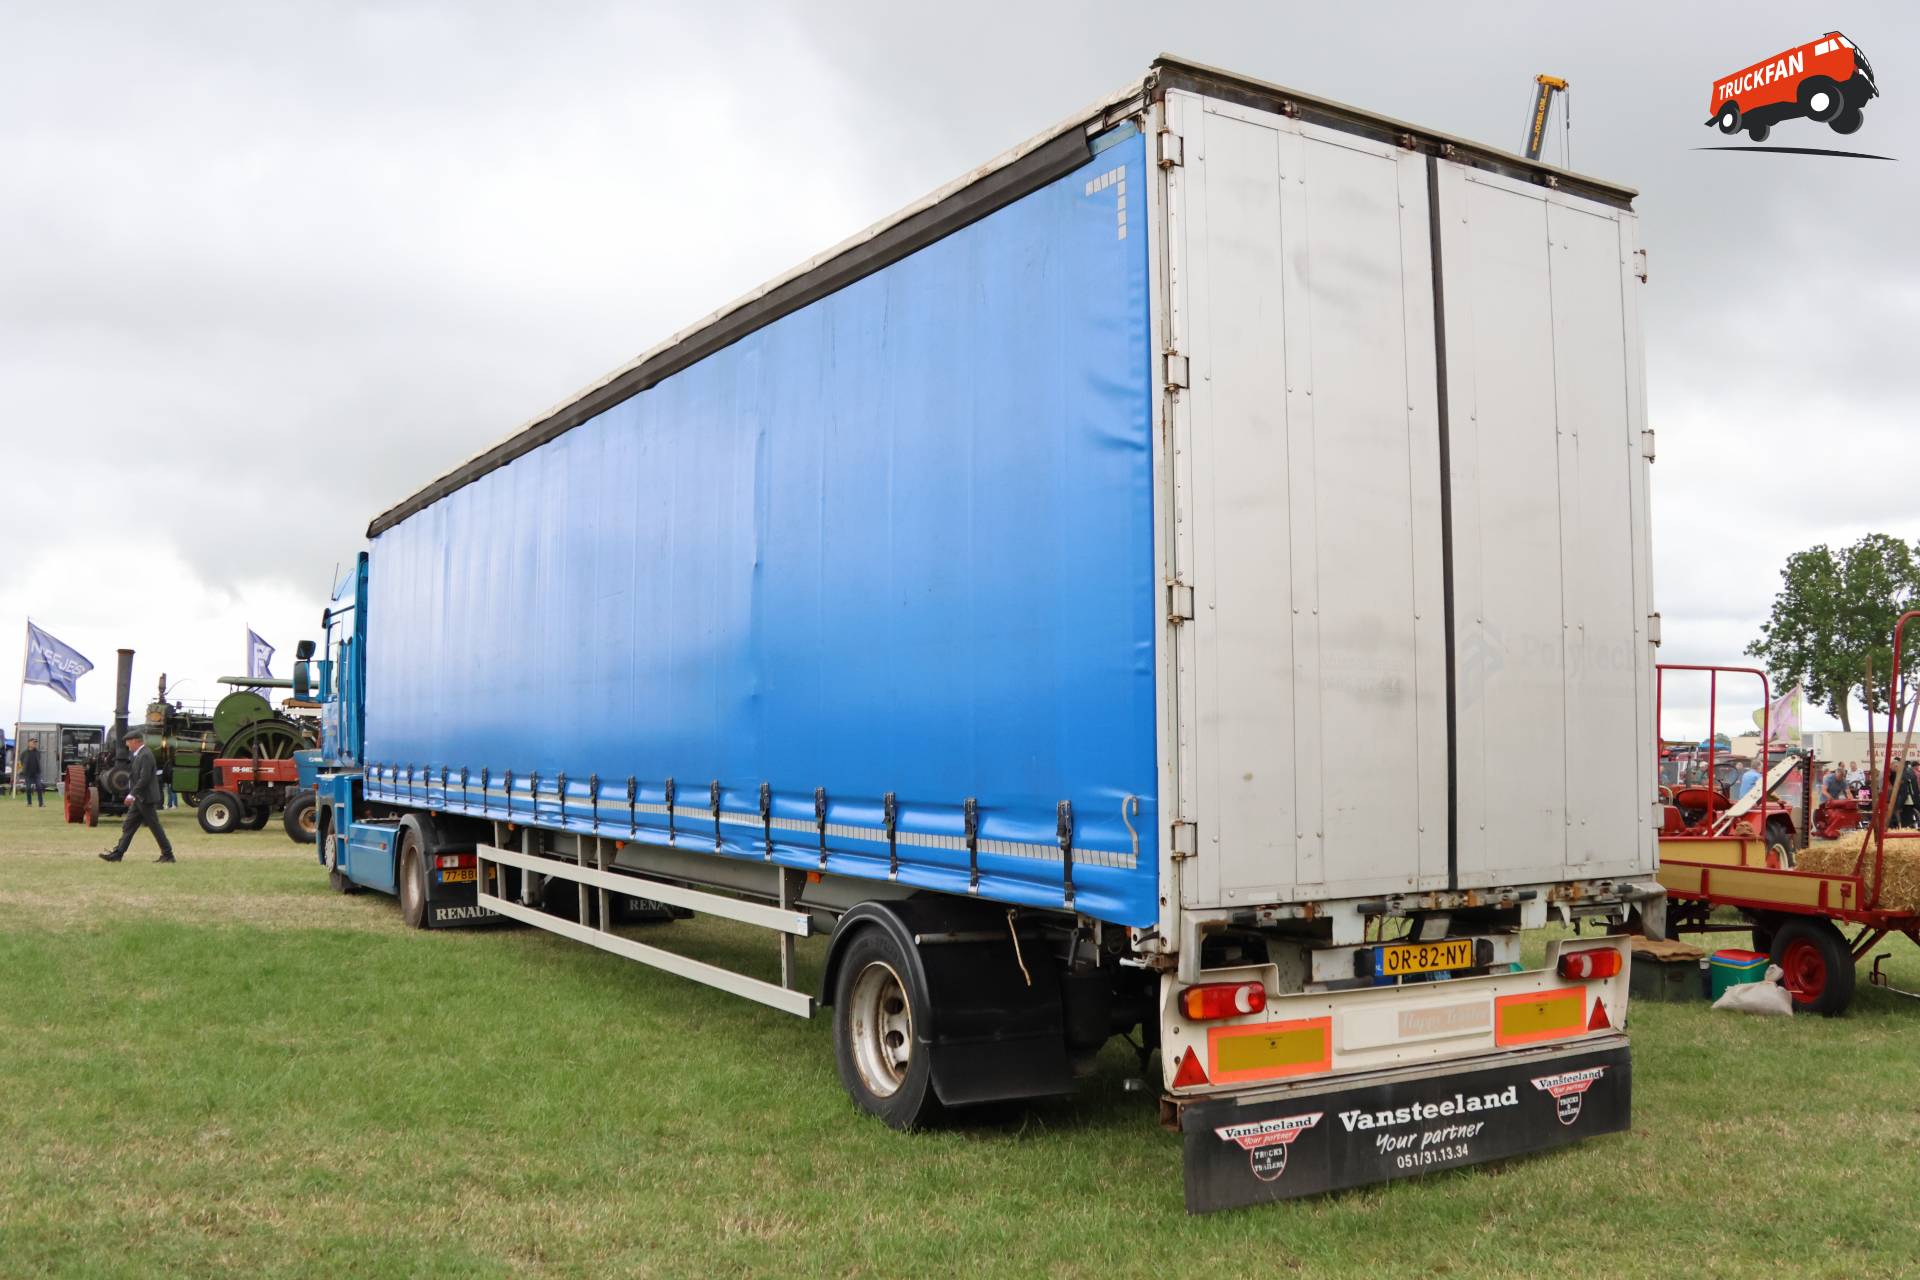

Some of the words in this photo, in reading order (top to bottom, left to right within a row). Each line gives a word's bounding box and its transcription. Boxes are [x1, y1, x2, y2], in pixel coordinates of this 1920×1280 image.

[435, 905, 500, 921] RENAUL
[1388, 944, 1467, 971] OR-82-NY
[1539, 1069, 1601, 1088] Vansteeland
[1338, 1085, 1519, 1132] Vansteeland
[1224, 1116, 1312, 1138] Vansteeland
[1376, 1133, 1418, 1155] Your
[1420, 1121, 1485, 1150] partner
[1244, 1136, 1262, 1146] Your
[1262, 1131, 1294, 1144] partner
[1254, 1148, 1283, 1160] TRUCKS
[1396, 1143, 1469, 1169] 051/31.13.34
